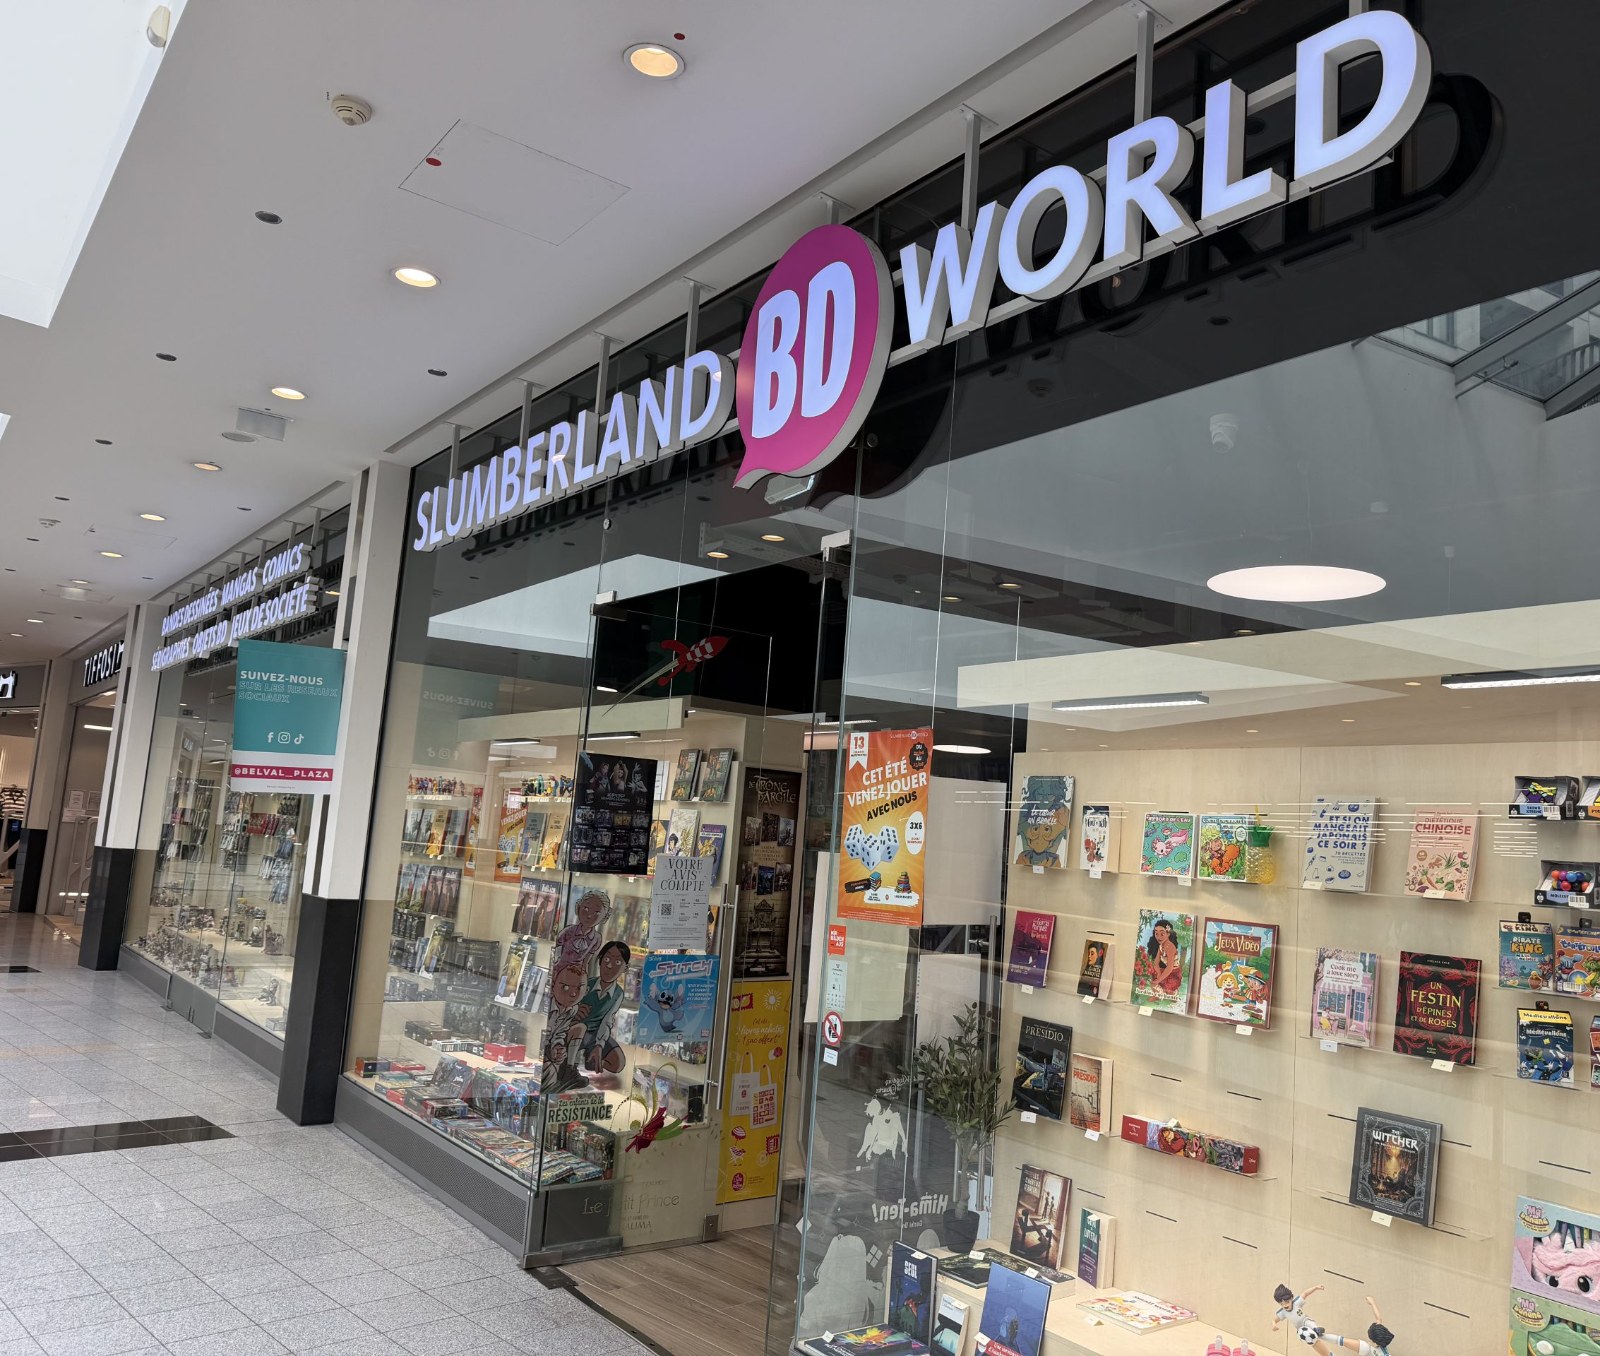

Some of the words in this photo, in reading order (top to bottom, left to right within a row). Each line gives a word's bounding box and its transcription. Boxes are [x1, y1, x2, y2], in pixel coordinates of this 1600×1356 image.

[413, 350, 727, 551] SLUMBERLAND
[751, 261, 856, 440] BD
[900, 10, 1422, 345] WORLD
[221, 567, 259, 606] MANGAS
[262, 543, 304, 586] COMICS
[251, 605, 264, 631] DE
[263, 576, 310, 626] SOCIÉTÉ
[240, 670, 323, 686] SUIVEZ-NOUS
[239, 681, 262, 692] SUR
[264, 682, 285, 693] LES
[238, 691, 290, 703] SOCIAUX
[853, 736, 865, 750] 13
[234, 767, 330, 779] @BELVAL_PLAZA
[862, 766, 884, 786] CET
[885, 756, 908, 779] ÉTÉ
[847, 786, 885, 808] VENEZ
[886, 772, 928, 801] JOUER
[867, 801, 891, 821] AVEC
[891, 791, 918, 811] NOUS
[910, 822, 923, 830] 3X6
[1313, 823, 1369, 832] MANGEAIT
[1415, 823, 1472, 835] CHINOISE
[1317, 832, 1368, 841] JAPONAIS
[1317, 840, 1330, 848] CE
[1333, 840, 1357, 850] SOIR
[668, 858, 703, 870] VOTRE
[671, 869, 698, 880] AVIS
[660, 880, 705, 891] COMPTE
[1214, 933, 1236, 952] JEUX
[649, 959, 713, 978] STITCH
[1430, 981, 1442, 990] UN
[1410, 989, 1462, 1010] FESTIN
[1428, 1017, 1457, 1029] ROSES
[1025, 1025, 1064, 1042] PRESIDIO
[1073, 1069, 1098, 1084] PRESIDIO
[548, 1104, 614, 1123] RÉSISTANCE
[1372, 1130, 1419, 1151] WITCHER
